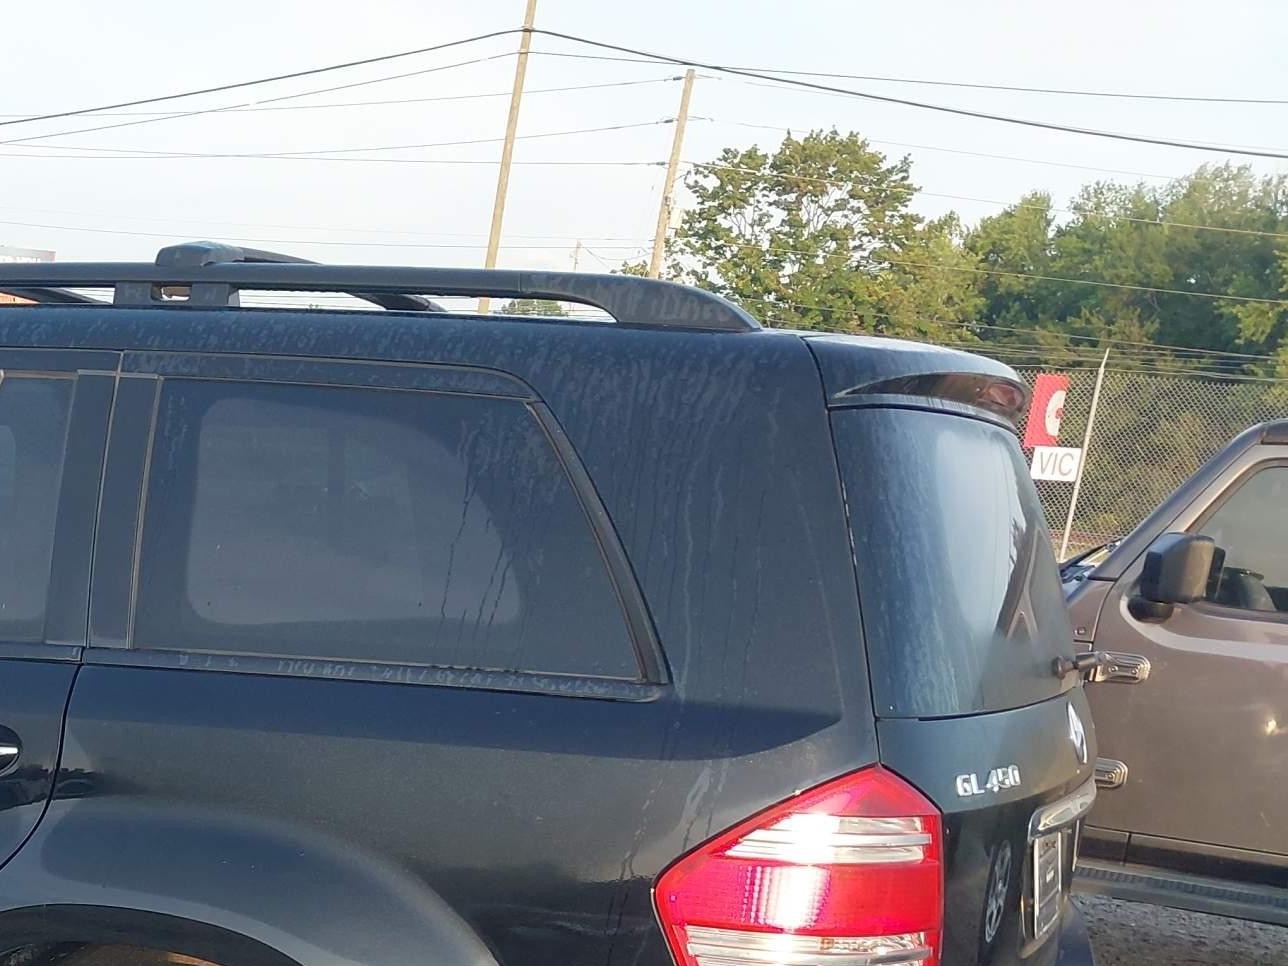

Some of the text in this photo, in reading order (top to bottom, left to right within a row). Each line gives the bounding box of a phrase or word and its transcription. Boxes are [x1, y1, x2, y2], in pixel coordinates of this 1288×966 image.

[1040, 452, 1075, 477] VIC
[956, 764, 1022, 797] GL 450
